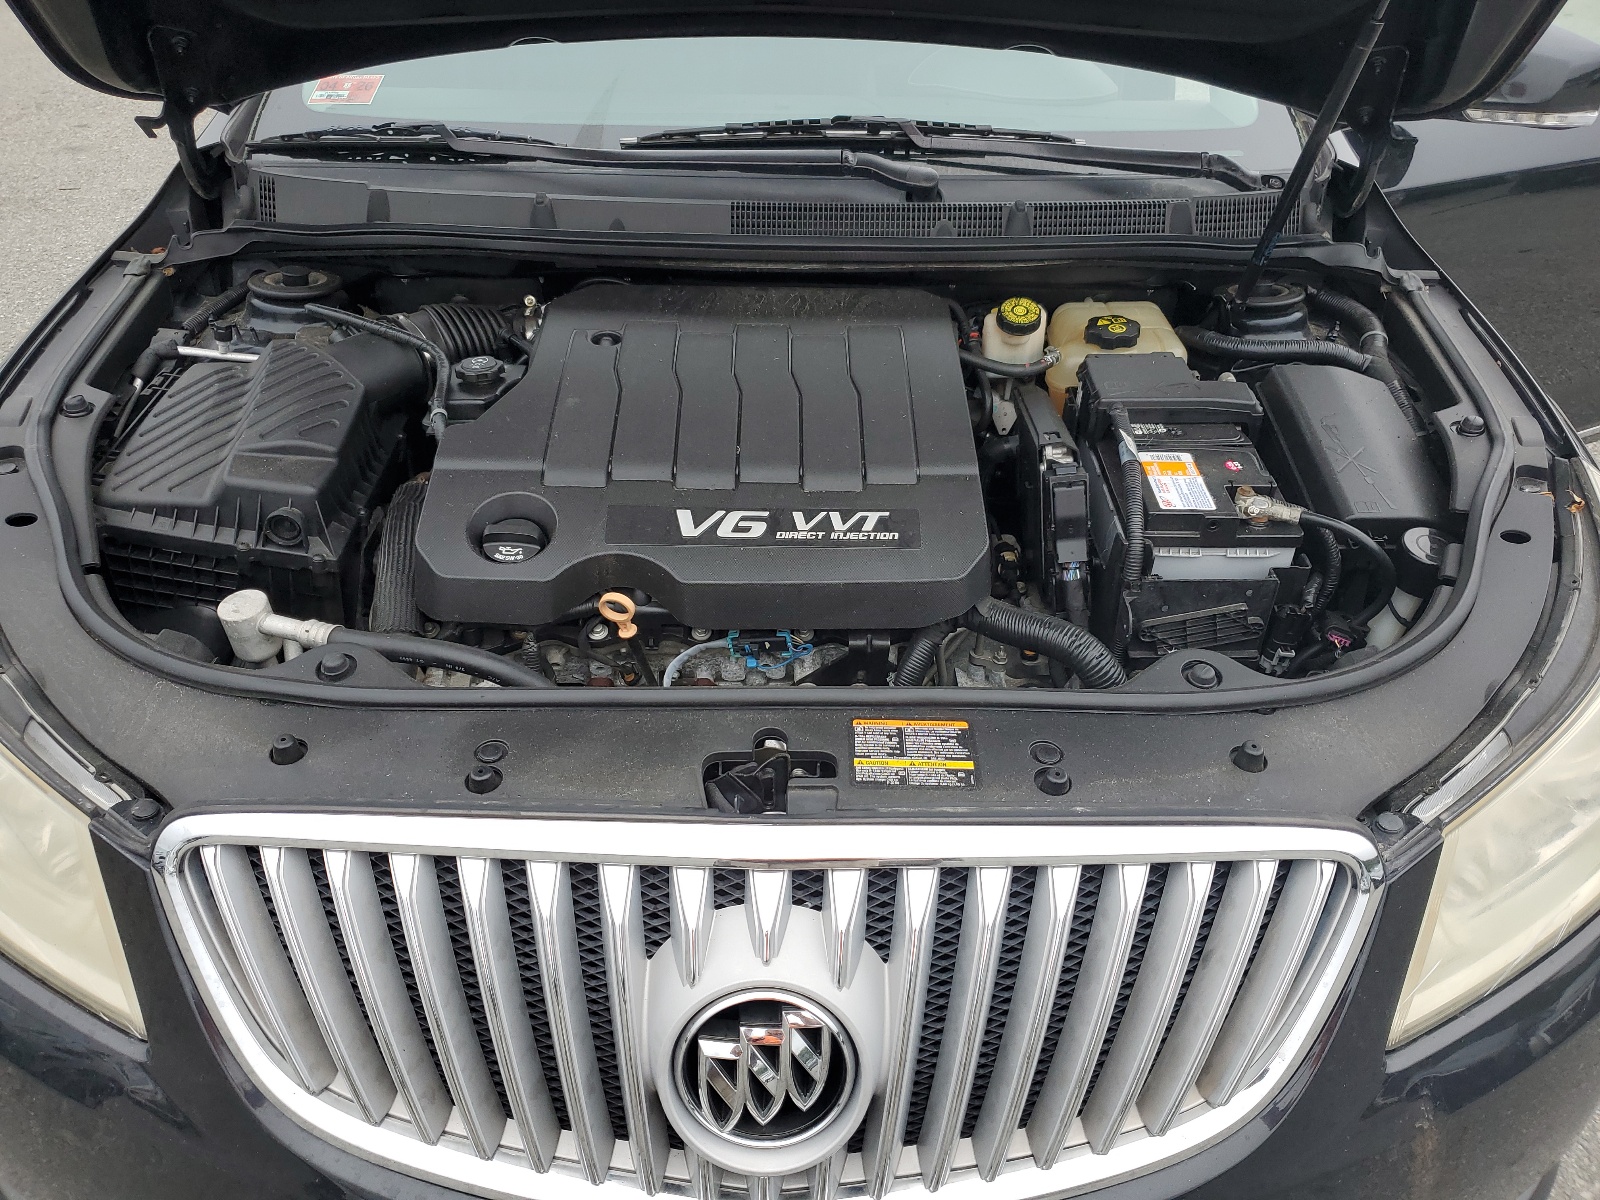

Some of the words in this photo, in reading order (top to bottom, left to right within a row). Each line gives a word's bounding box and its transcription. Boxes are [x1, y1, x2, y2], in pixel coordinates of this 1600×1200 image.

[675, 509, 770, 539] V6
[792, 511, 890, 532] VVT
[775, 531, 826, 540] DIRECT
[829, 532, 899, 541] INJECTION
